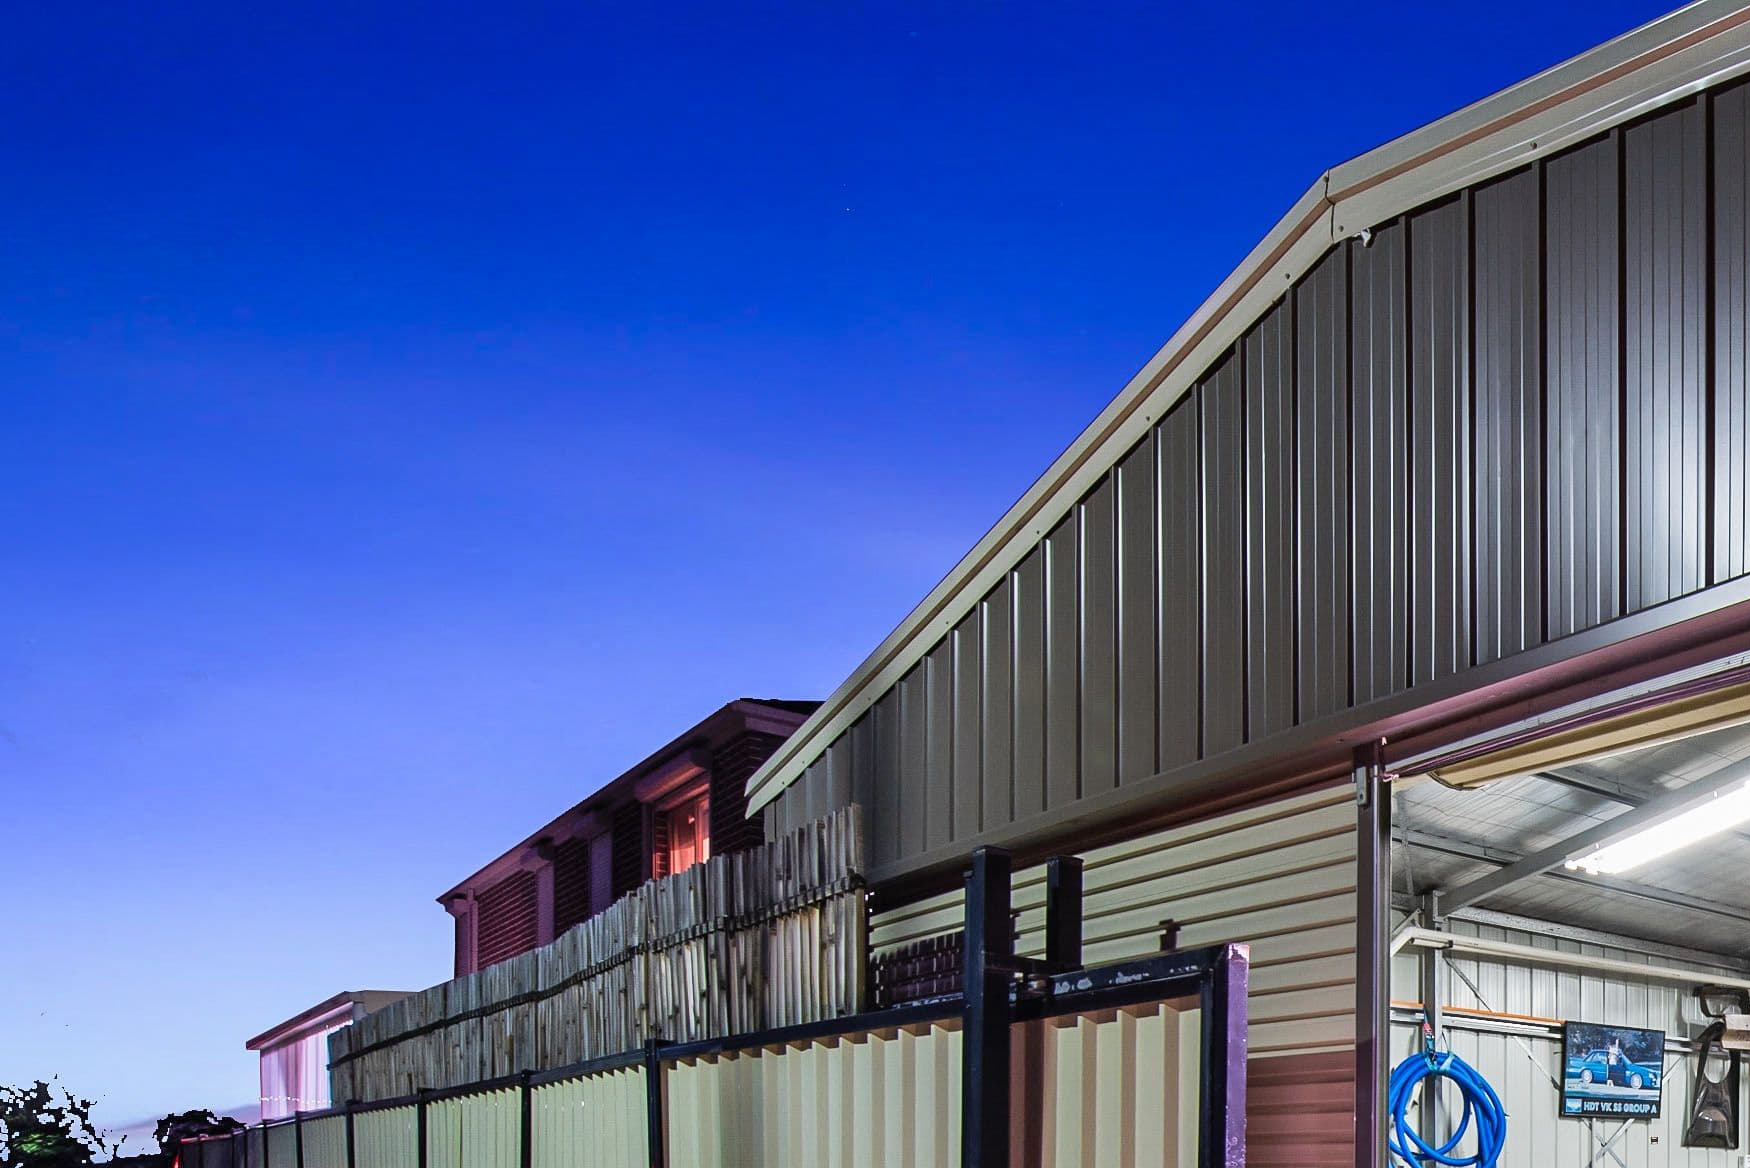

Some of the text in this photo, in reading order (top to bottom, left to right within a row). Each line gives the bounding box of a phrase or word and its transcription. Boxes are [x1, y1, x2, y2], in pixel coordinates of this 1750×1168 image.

[1583, 1101, 1657, 1114] HDT VK SS GROUP A
